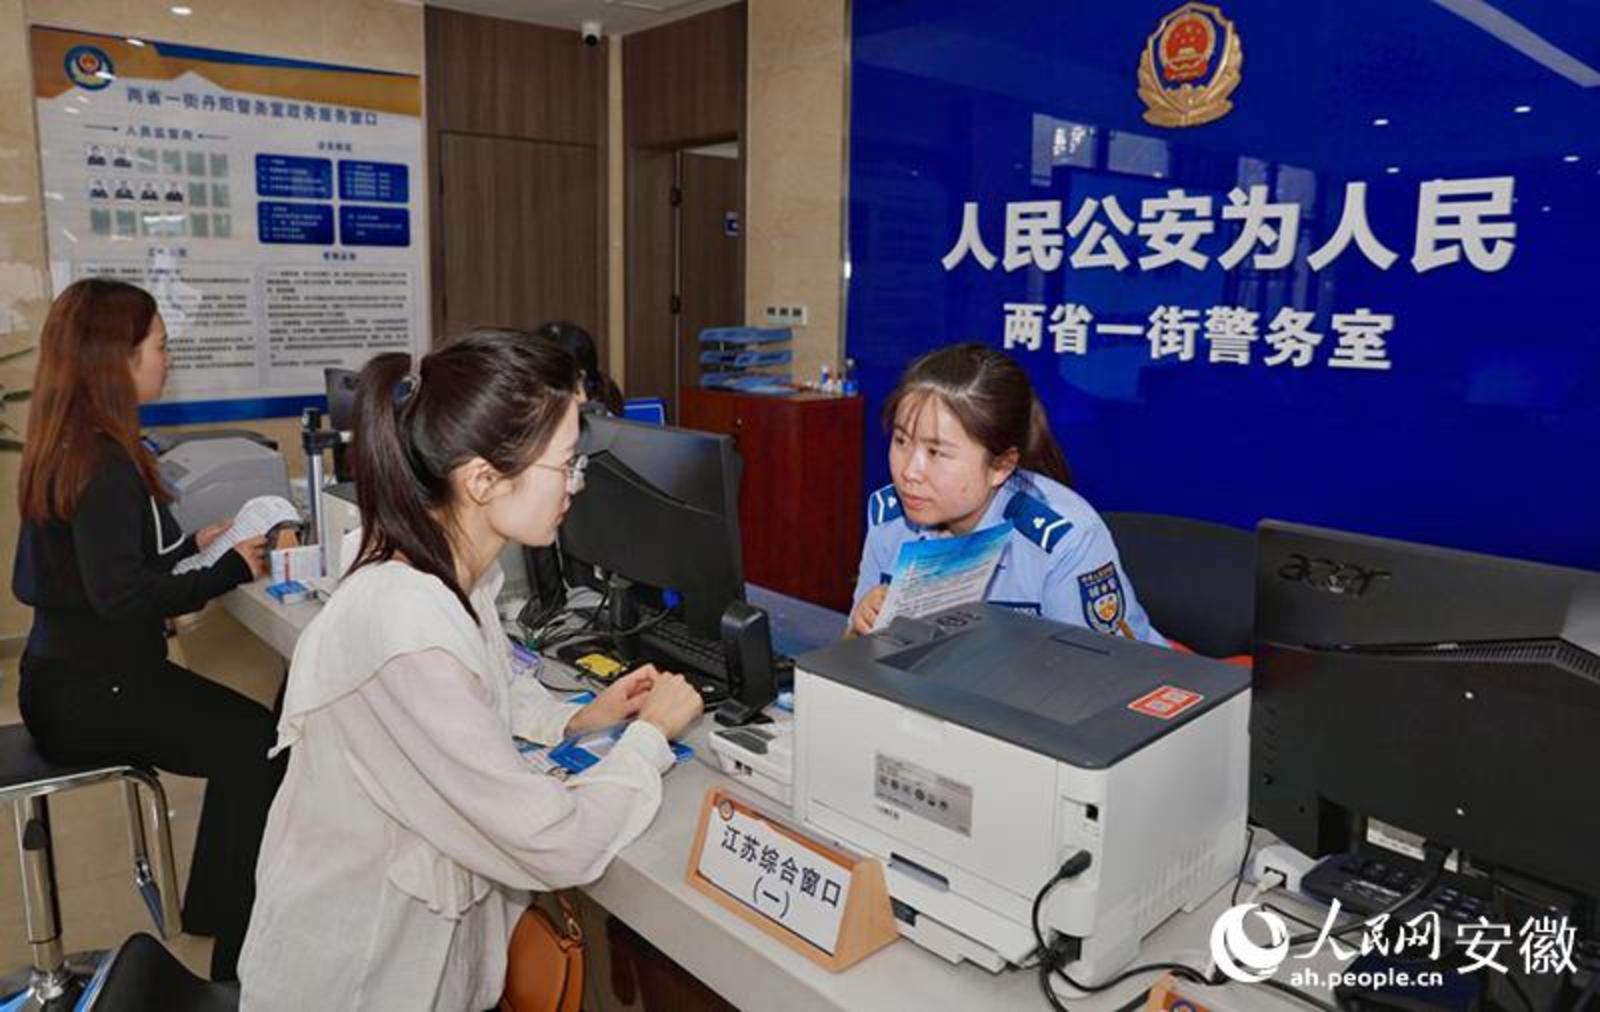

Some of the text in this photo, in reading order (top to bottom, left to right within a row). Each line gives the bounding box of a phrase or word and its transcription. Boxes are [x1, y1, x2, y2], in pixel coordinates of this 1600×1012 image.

[942, 176, 1517, 273] 人民公安为人民
[1002, 302, 1395, 370] 两省一街警务室
[1278, 553, 1393, 598] acer
[720, 824, 842, 908] 江苏综合窗口
